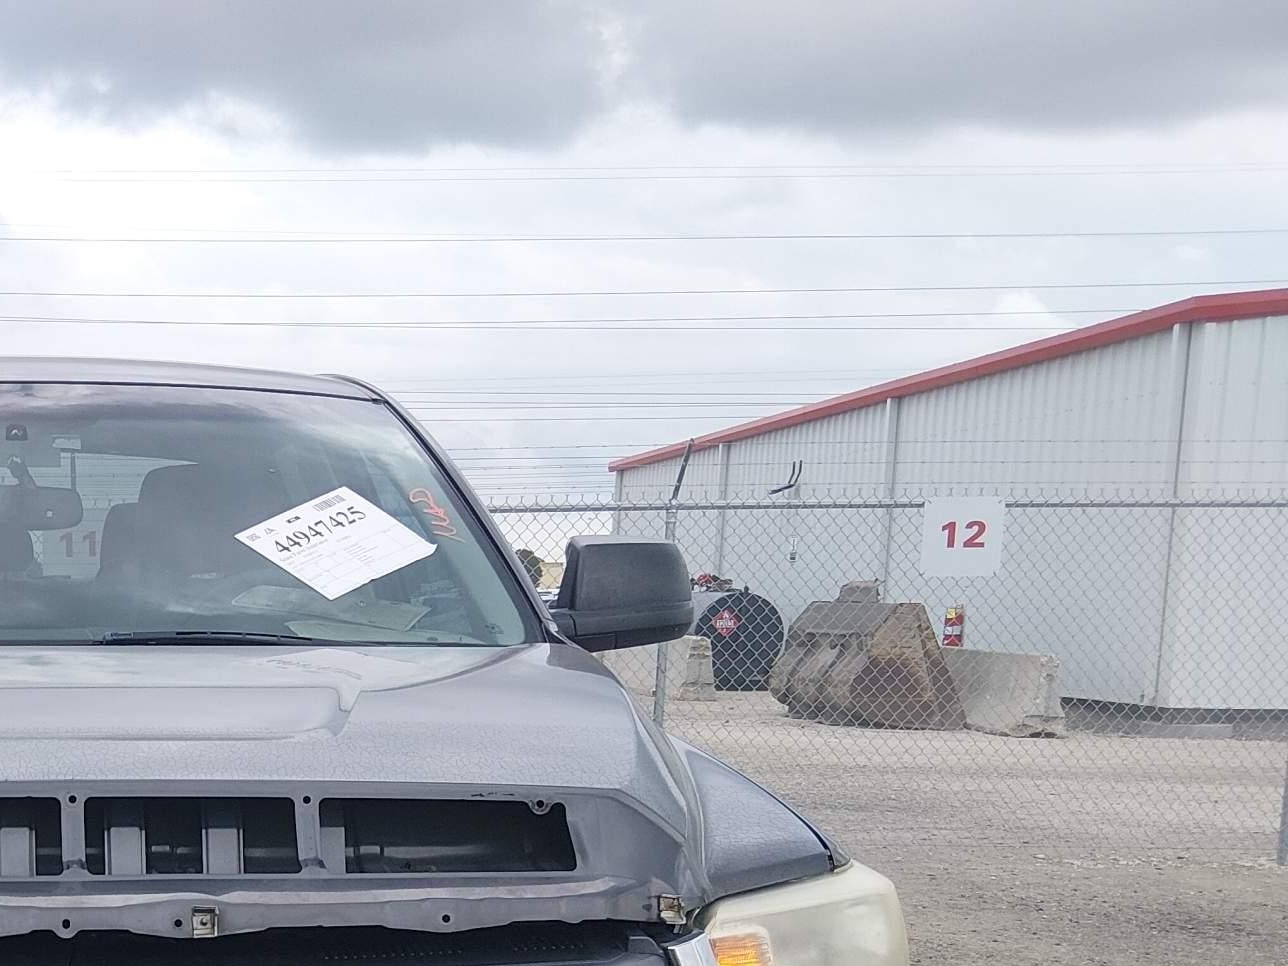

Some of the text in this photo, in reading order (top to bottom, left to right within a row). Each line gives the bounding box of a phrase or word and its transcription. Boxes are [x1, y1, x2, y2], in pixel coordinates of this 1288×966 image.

[58, 530, 97, 558] 11
[274, 505, 367, 555] 44947425
[941, 520, 987, 549] 12
